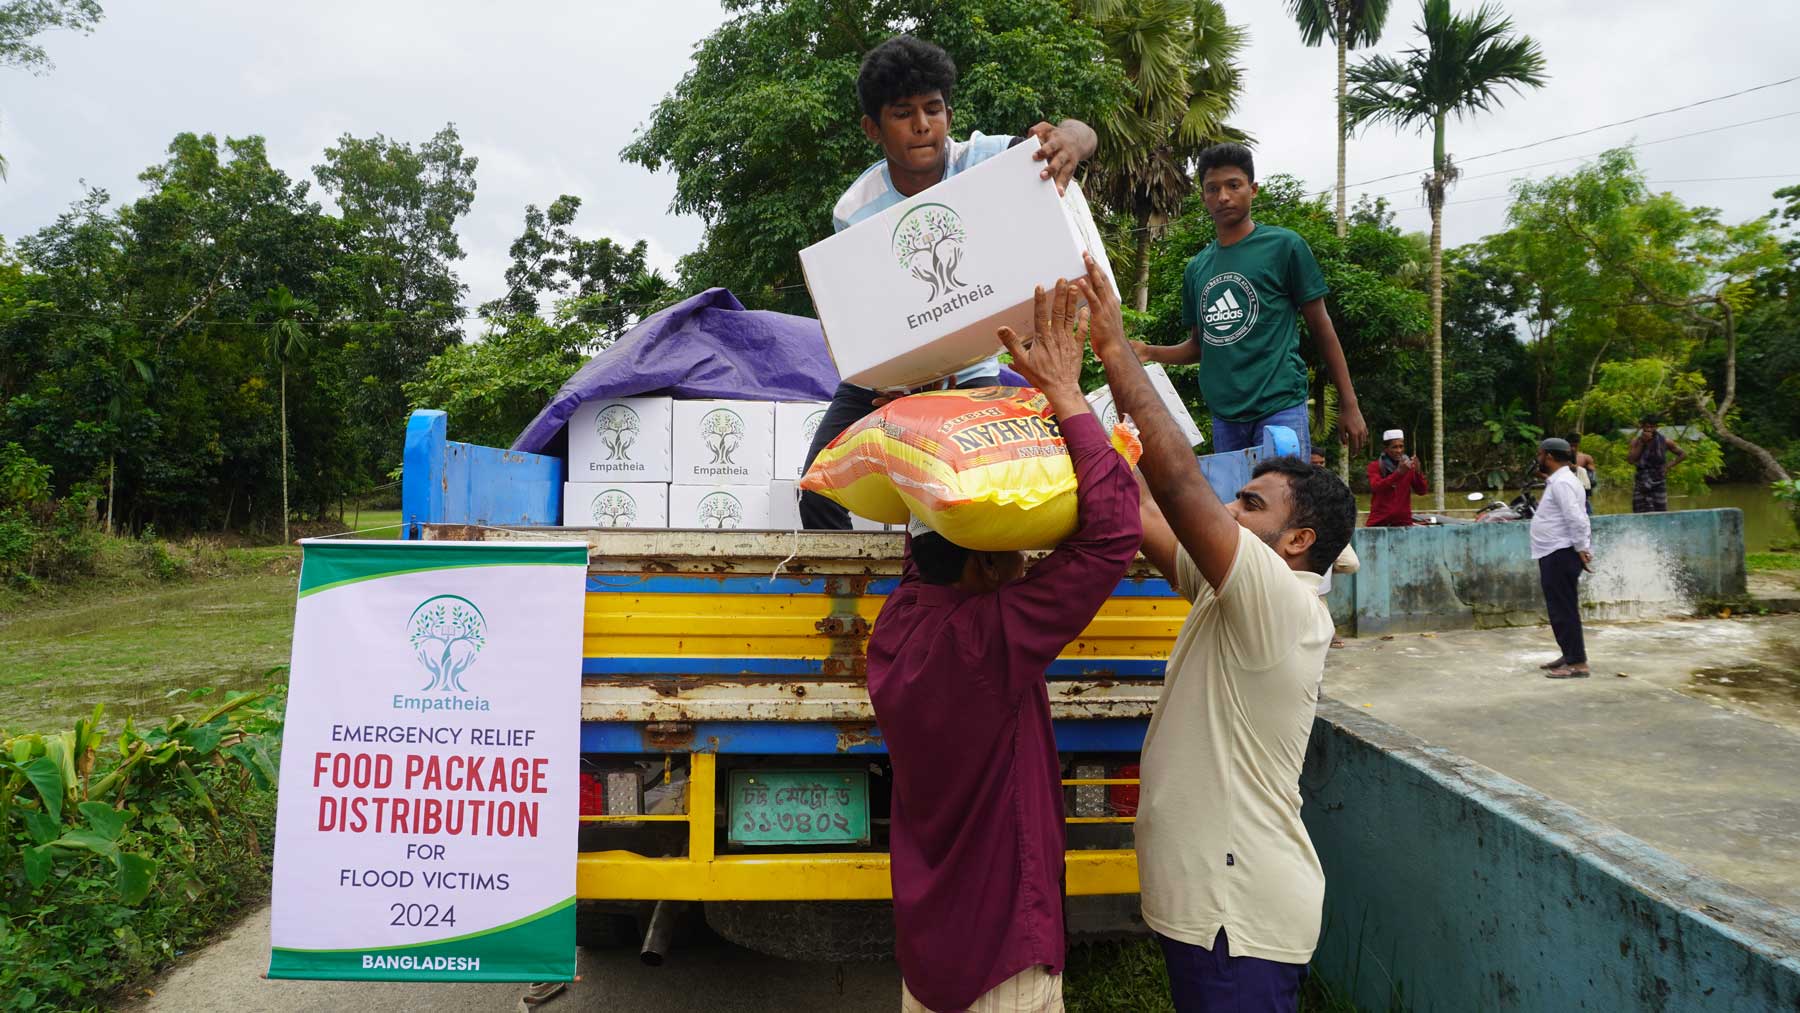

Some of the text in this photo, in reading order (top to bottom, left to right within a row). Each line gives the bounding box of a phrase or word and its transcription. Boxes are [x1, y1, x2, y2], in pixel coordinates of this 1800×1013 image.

[1241, 280, 1256, 302] ATHLETE
[906, 281, 995, 330] Empatheia
[1205, 309, 1244, 323] adidas
[938, 407, 1003, 433] Brand
[589, 461, 645, 473] Empatheia
[693, 465, 749, 477] Empatheia
[393, 694, 490, 713] Empatheia
[332, 725, 536, 747] EMERGENCY RELIEF
[313, 752, 550, 794] FOOD PACKAGE
[317, 796, 540, 838] DISTRIBUTION
[406, 844, 446, 861] FOR
[339, 869, 510, 891] FLOOD VICTIMS
[389, 903, 457, 928] 2024
[362, 955, 480, 971] BANGLADESH
